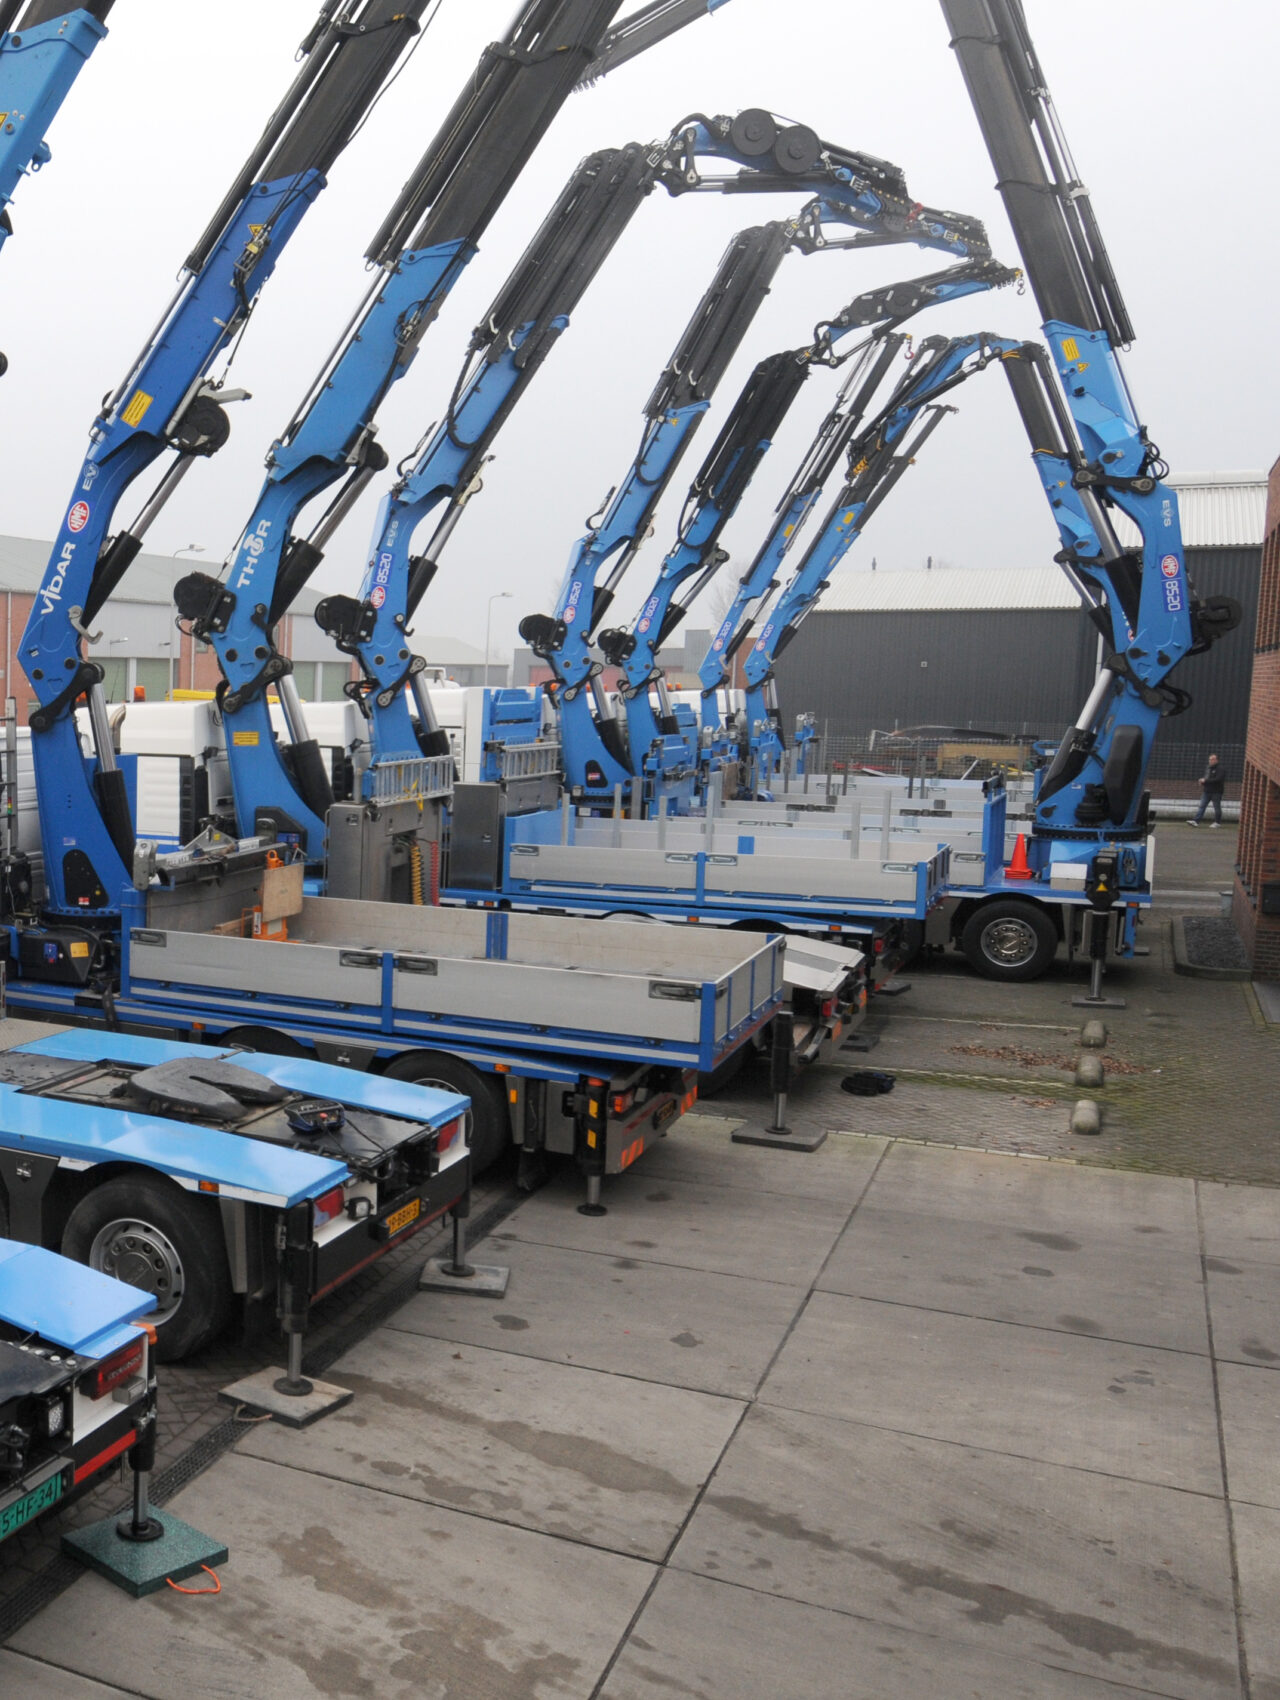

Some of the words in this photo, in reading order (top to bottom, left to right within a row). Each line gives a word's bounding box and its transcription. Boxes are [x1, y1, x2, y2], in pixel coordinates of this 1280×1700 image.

[68, 502, 89, 532] HMF
[1162, 500, 1171, 527] EVS
[237, 519, 271, 589] THOR
[377, 553, 392, 583] 8520
[1162, 555, 1178, 577] HMF
[40, 542, 76, 615] VIDAR
[1165, 580, 1180, 611] 8520
